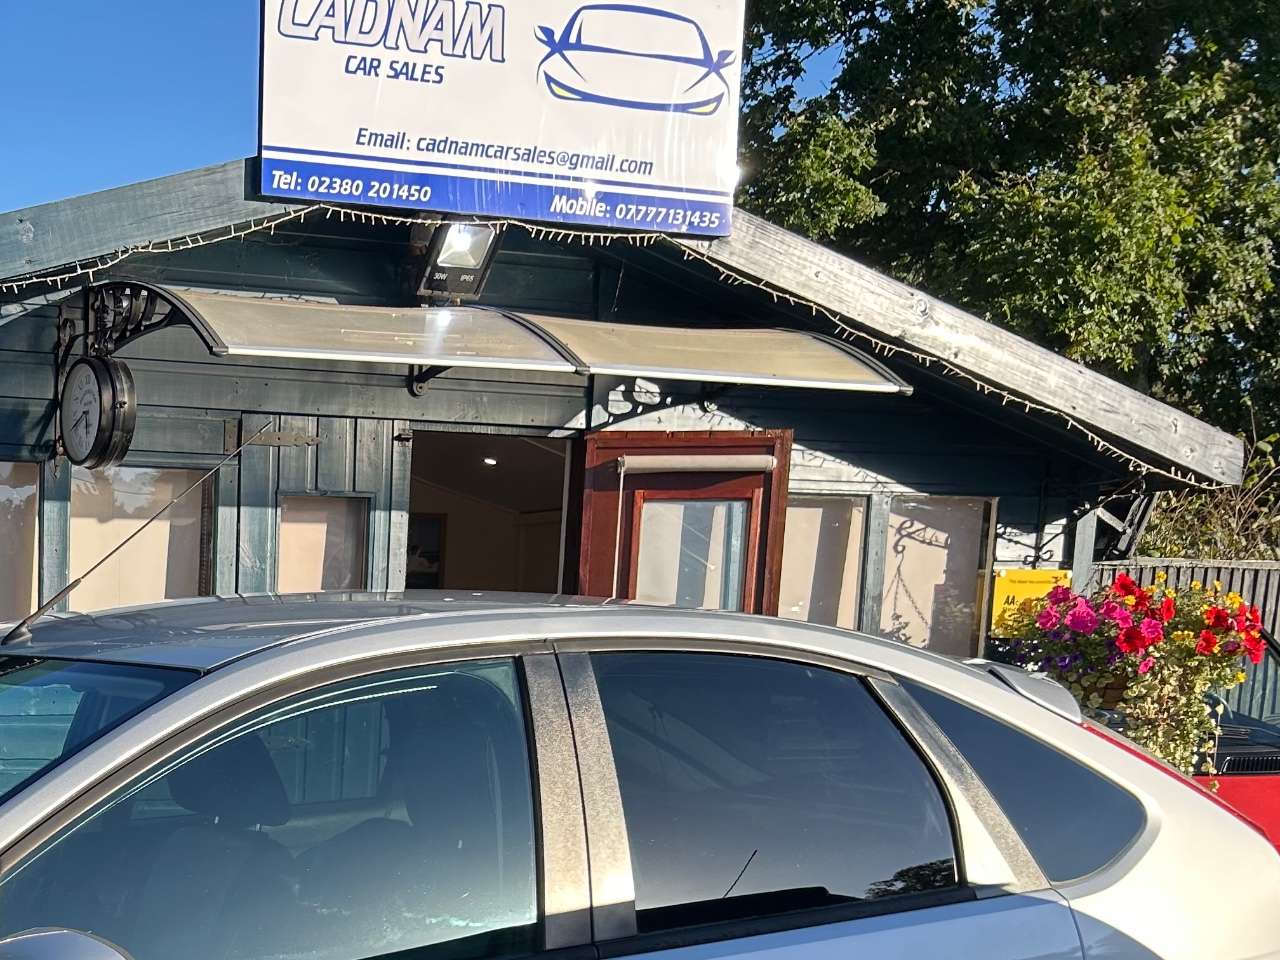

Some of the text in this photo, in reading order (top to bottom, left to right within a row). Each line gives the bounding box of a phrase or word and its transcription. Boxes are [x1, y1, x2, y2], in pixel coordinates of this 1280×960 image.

[278, 0, 506, 63] CADNAM
[344, 54, 445, 84] CAR SALES
[355, 126, 654, 176] Email: cadnamcarsales@gmail.com
[271, 170, 432, 202] Tel: 02380 201450
[550, 194, 721, 229] Mobile: 07777131435
